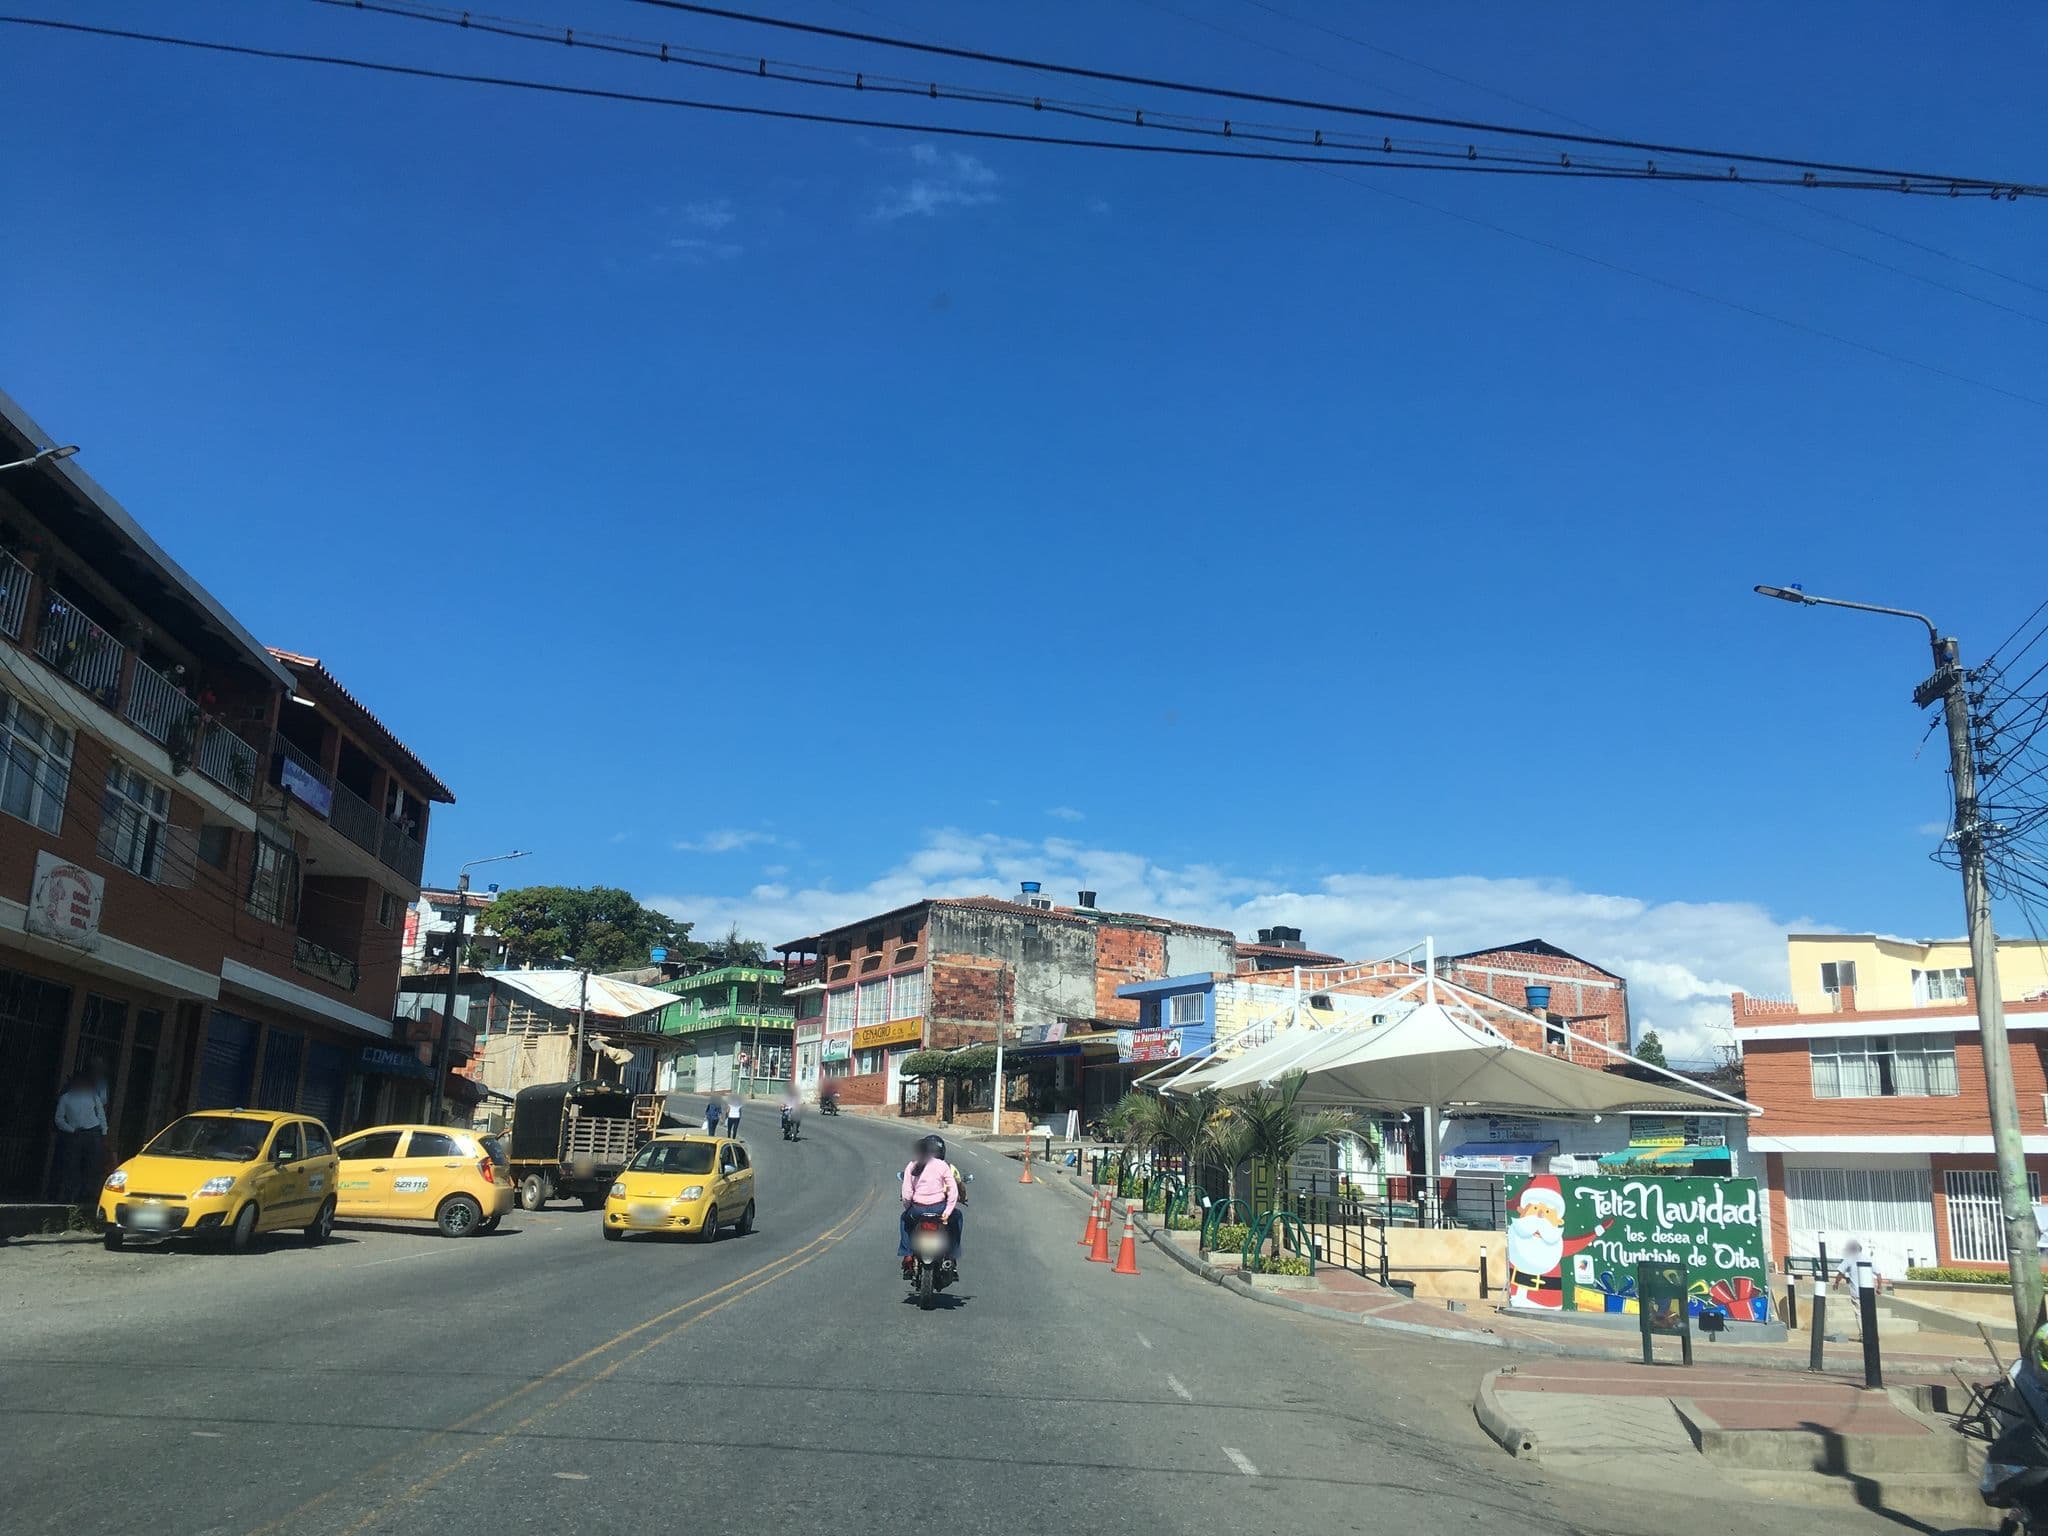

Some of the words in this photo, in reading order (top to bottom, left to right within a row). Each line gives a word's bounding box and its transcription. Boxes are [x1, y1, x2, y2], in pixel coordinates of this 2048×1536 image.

[680, 1019, 722, 1034] Lubricantes
[862, 1025, 891, 1041] CENAGRO
[1574, 1186, 1637, 1219] Feliz
[1623, 1182, 1758, 1229] Navidad
[1624, 1225, 1647, 1243] les
[1651, 1225, 1691, 1244] desea
[1696, 1227, 1709, 1245] el
[1688, 1248, 1708, 1267] de
[1712, 1243, 1761, 1270] Oiba
